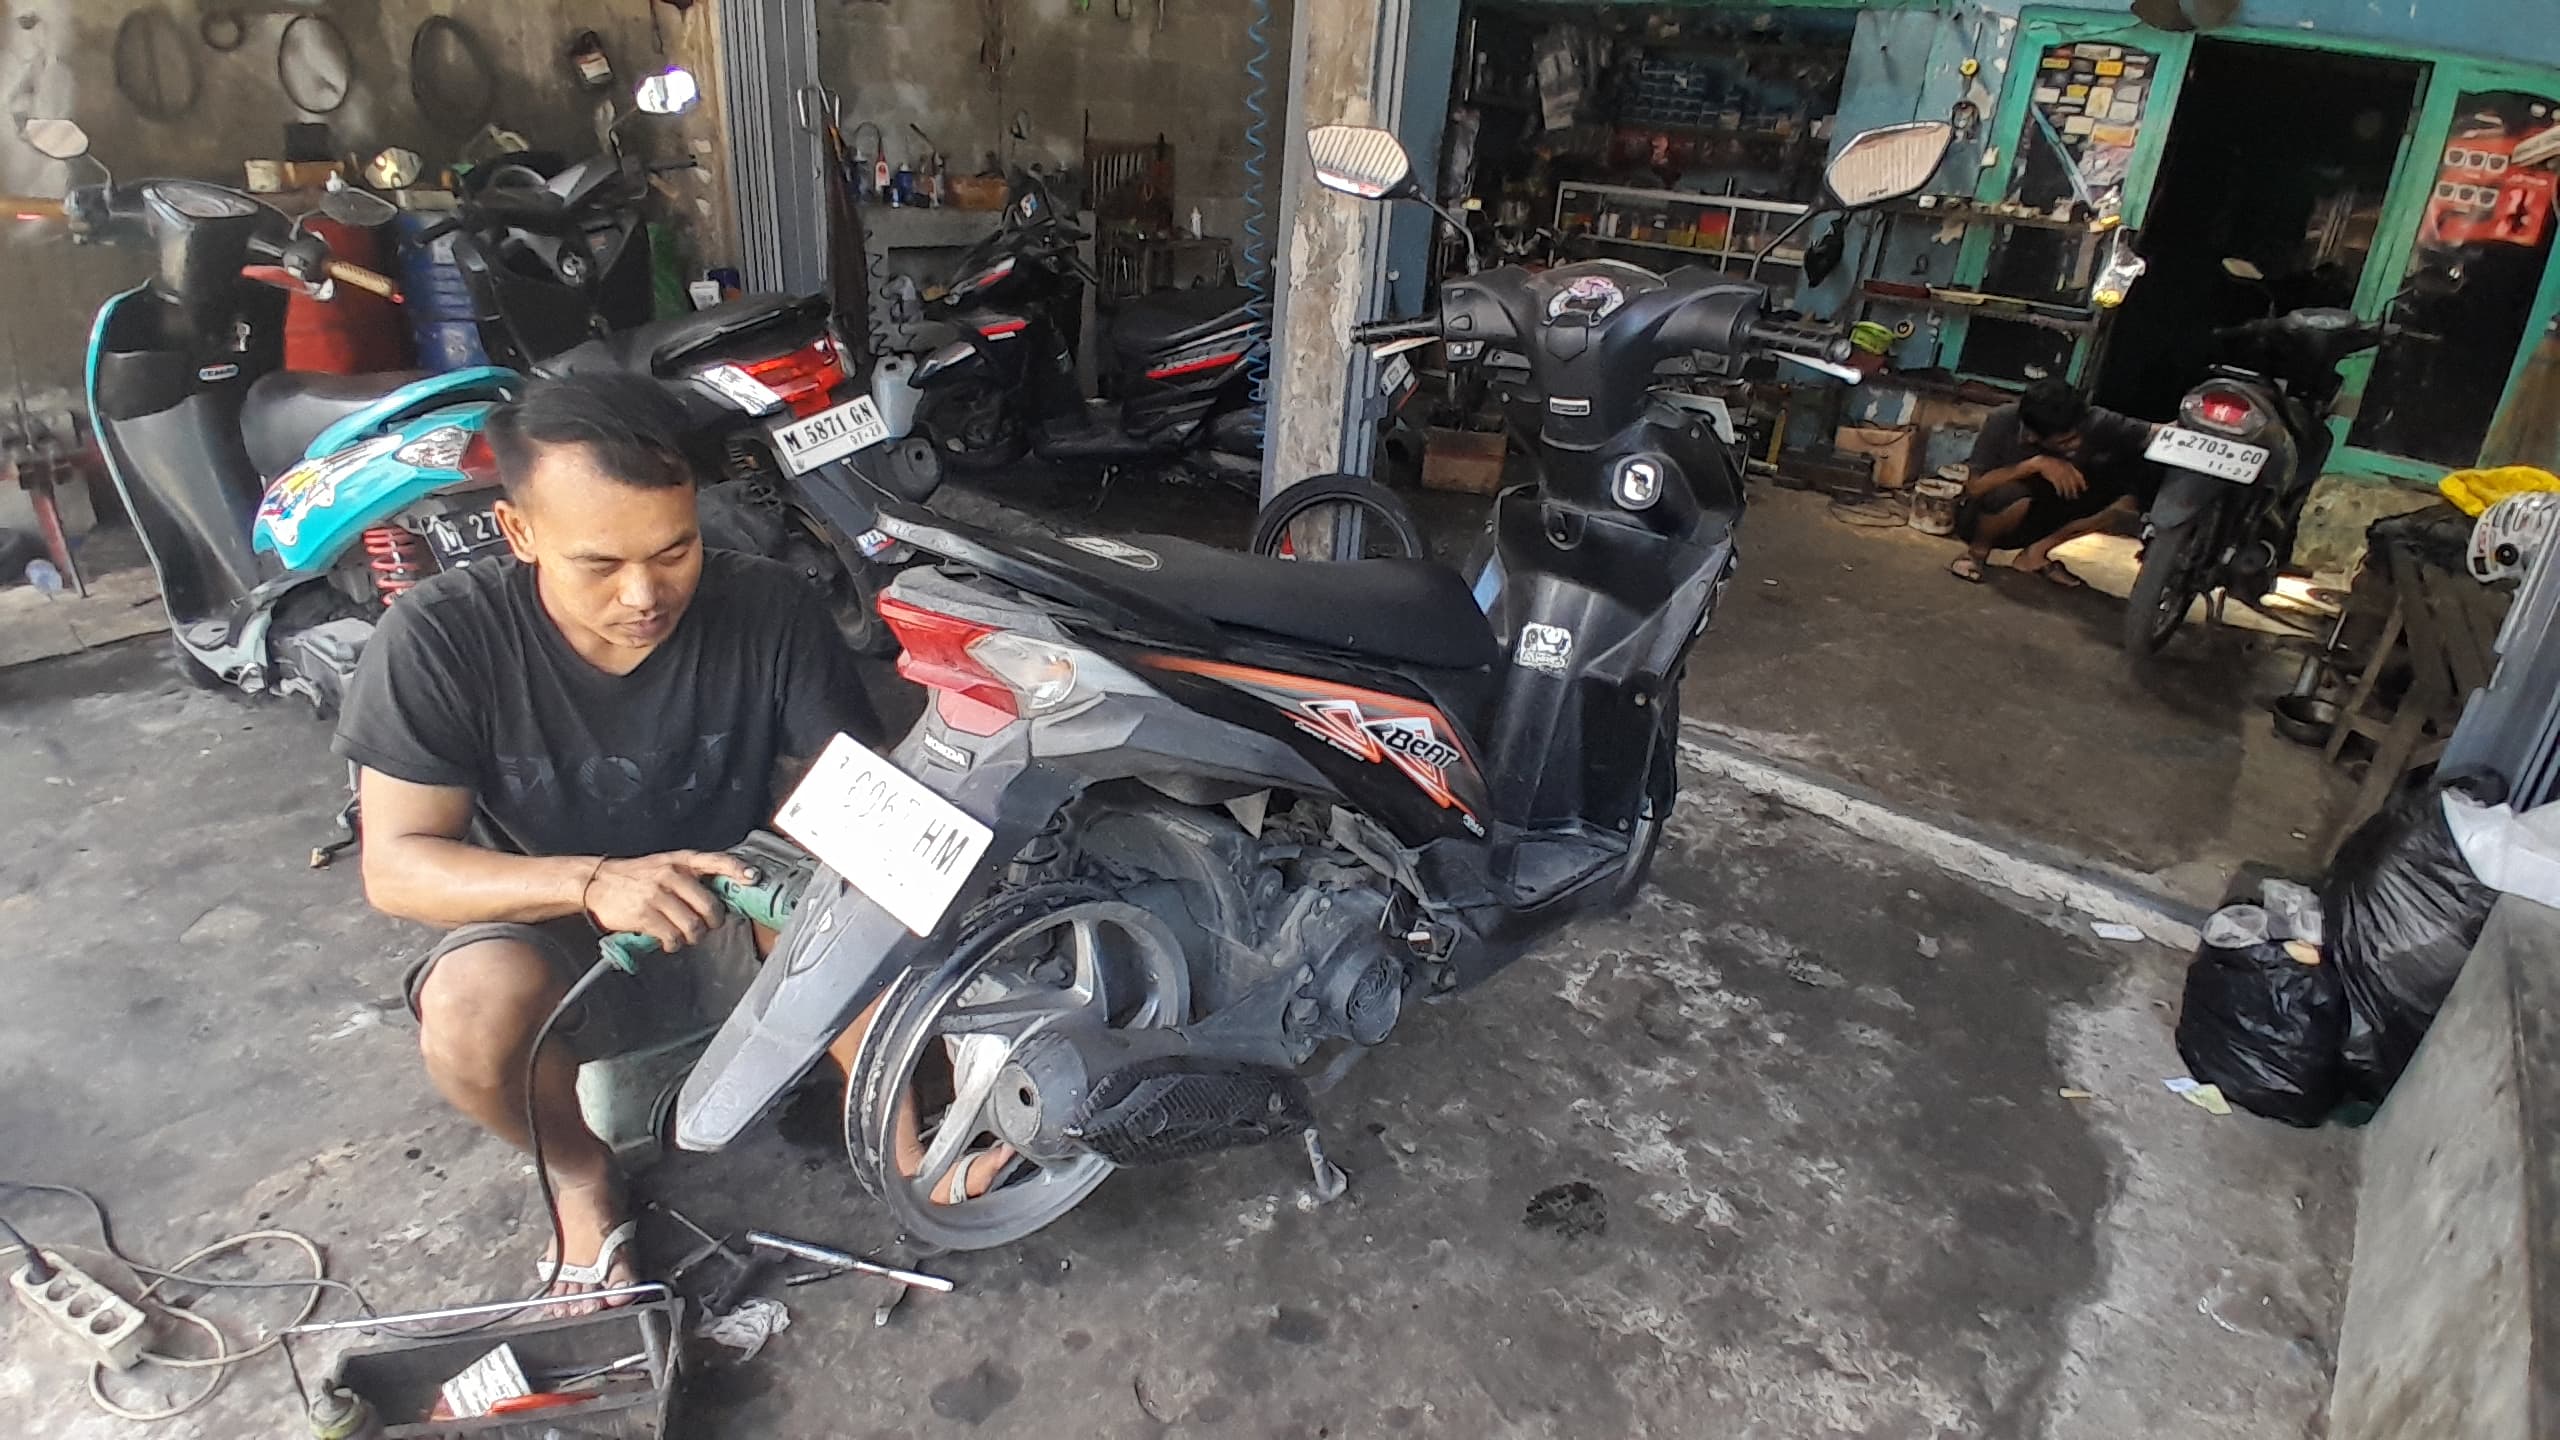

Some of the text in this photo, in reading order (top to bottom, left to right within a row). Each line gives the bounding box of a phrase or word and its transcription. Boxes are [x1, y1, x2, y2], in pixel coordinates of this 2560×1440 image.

[783, 402, 873, 453] M 5871 GN
[2160, 430, 2175, 442] M
[2185, 436, 2228, 456] 2703
[912, 818, 970, 876] HM
